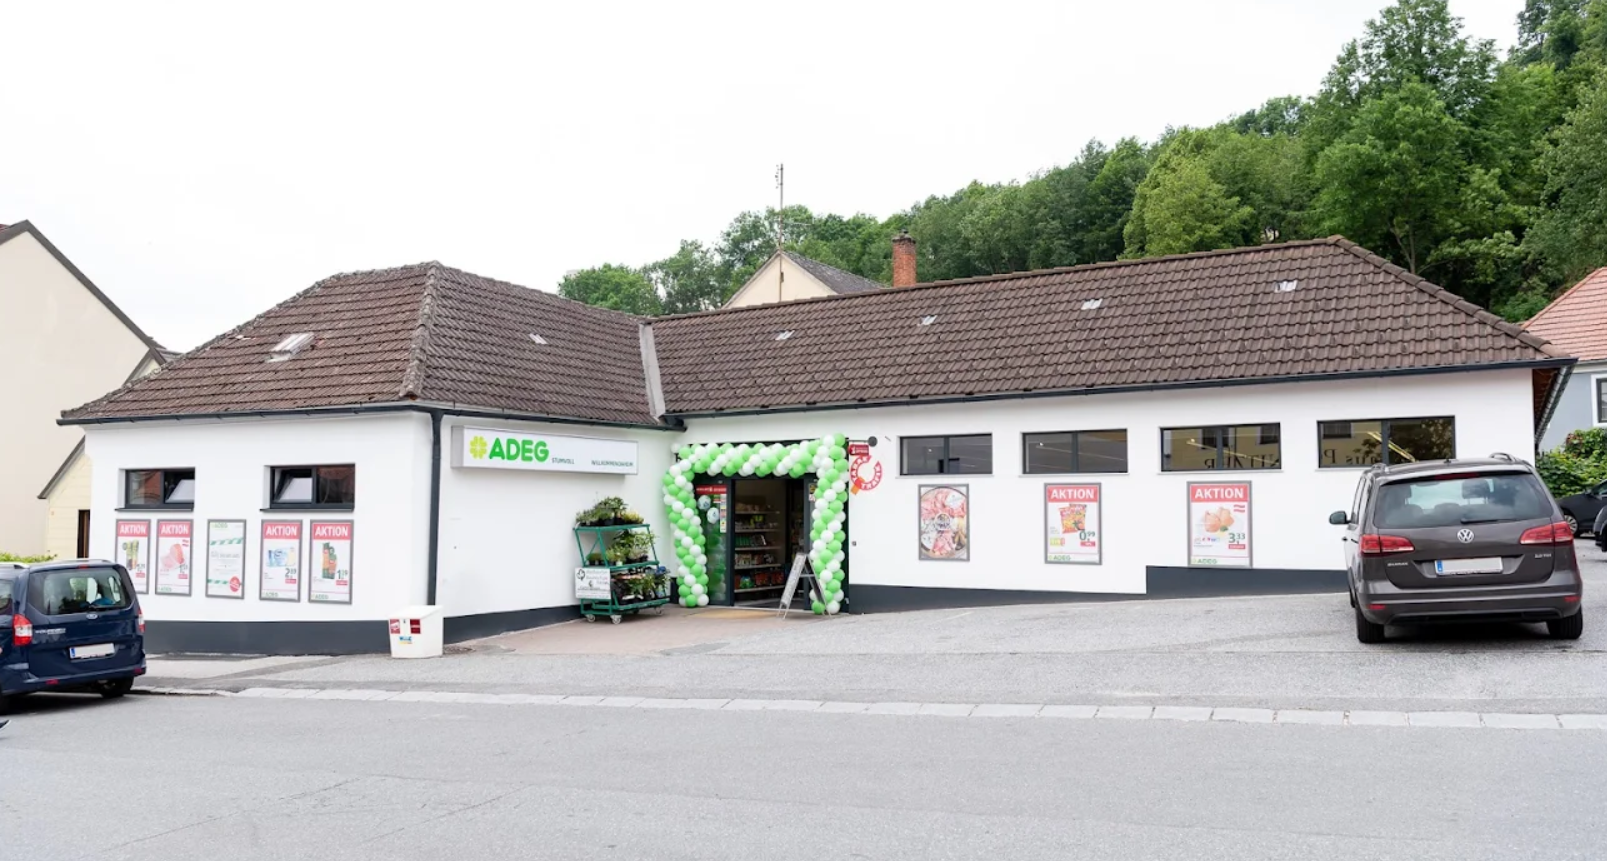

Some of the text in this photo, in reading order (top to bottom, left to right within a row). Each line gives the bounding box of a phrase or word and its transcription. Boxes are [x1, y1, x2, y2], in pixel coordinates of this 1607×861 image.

[488, 437, 549, 462] ADEG
[1050, 488, 1095, 500] AKTION
[1194, 487, 1244, 499] AKTION
[119, 524, 147, 535] AKTION
[160, 524, 189, 535] AKTION
[265, 525, 298, 536] AKTION
[314, 526, 348, 537] AKTION
